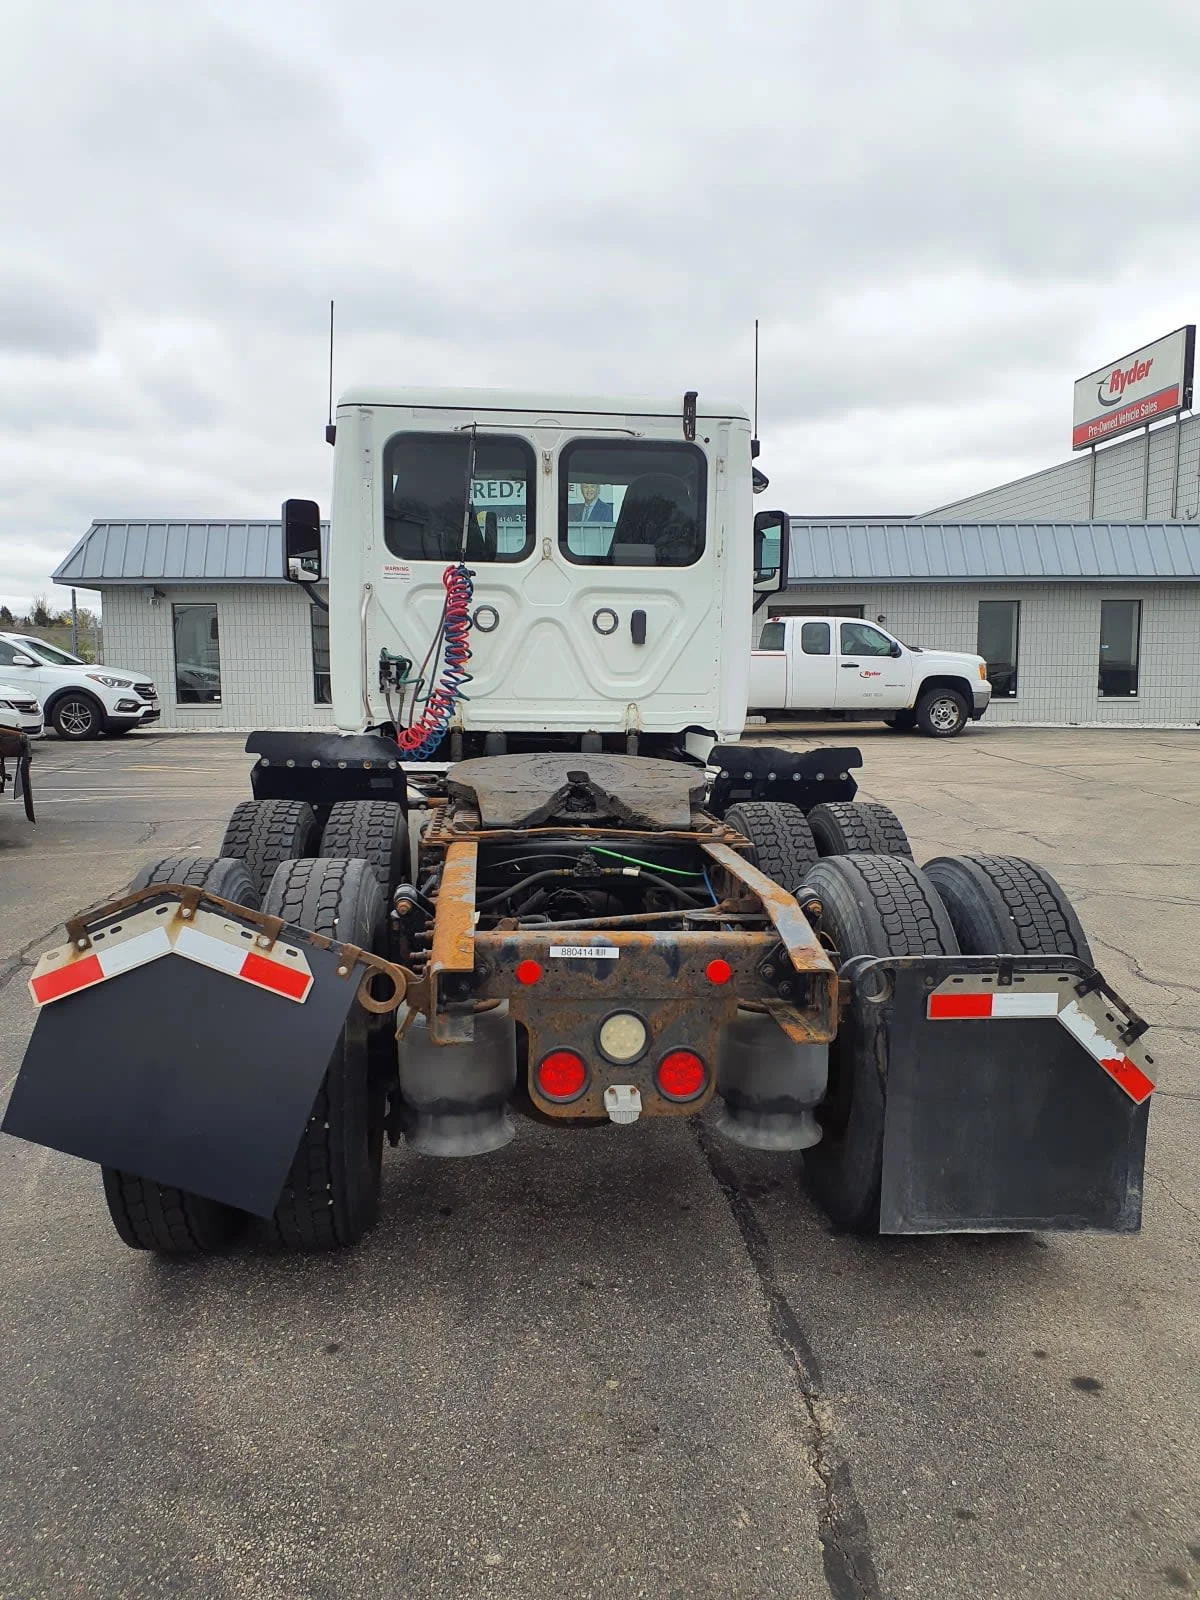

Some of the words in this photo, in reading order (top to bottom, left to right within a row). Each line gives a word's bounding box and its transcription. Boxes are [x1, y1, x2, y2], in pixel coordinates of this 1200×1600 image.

[1109, 357, 1154, 394] Ryder
[1088, 416, 1118, 437] Pre-Owned
[1119, 407, 1140, 425] Vehicle
[1140, 400, 1158, 417] Sales
[561, 947, 593, 957] 880414
